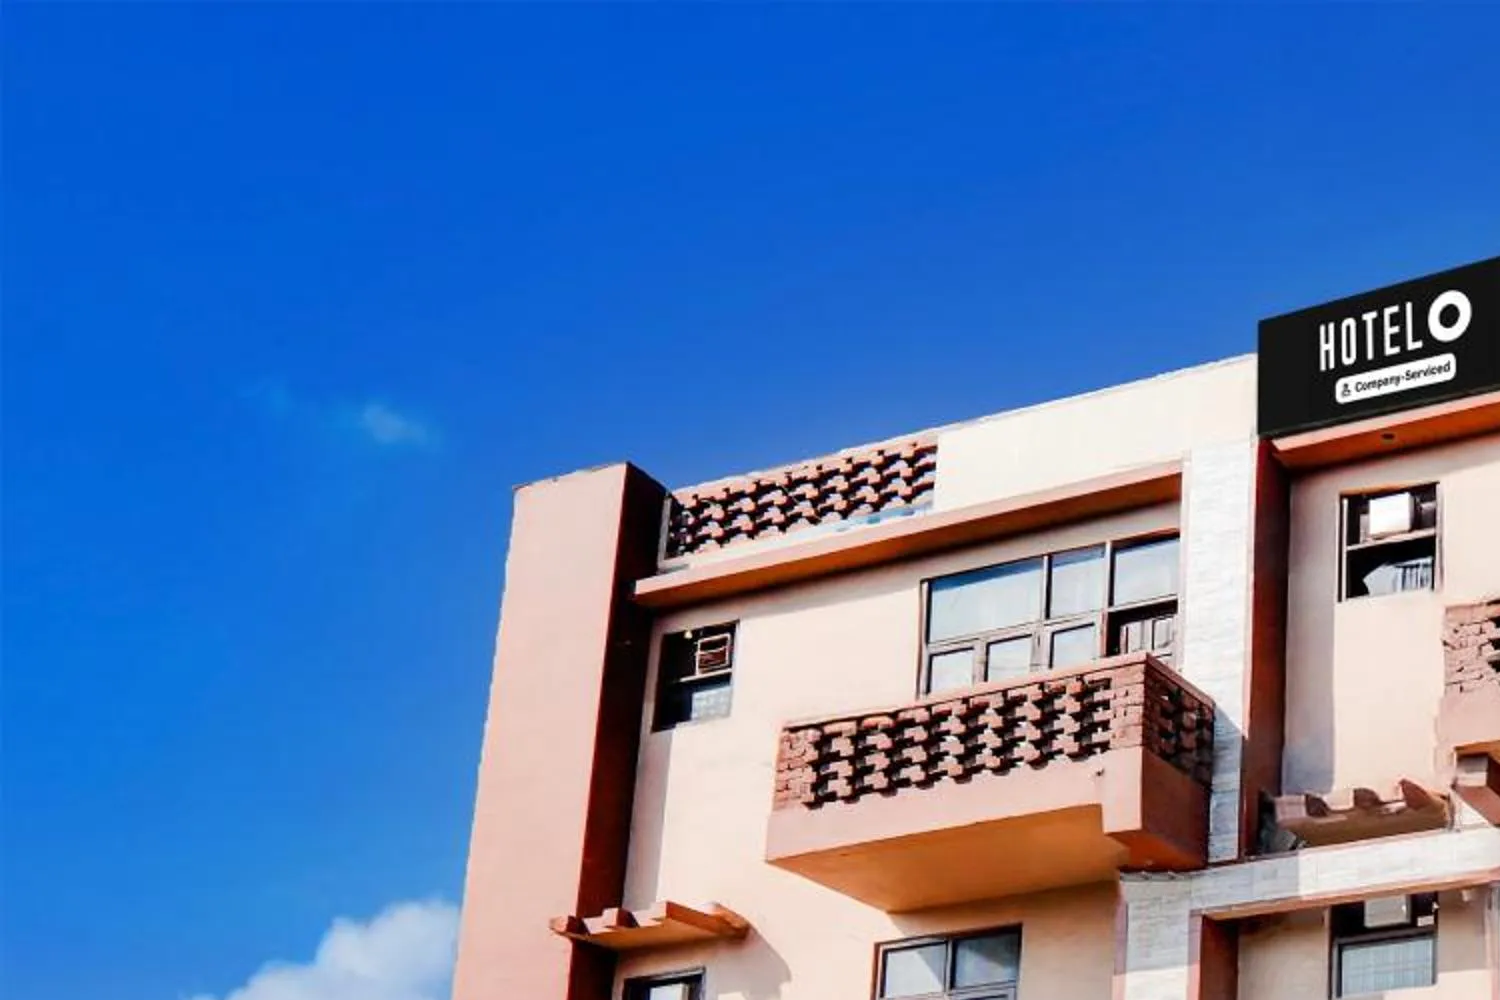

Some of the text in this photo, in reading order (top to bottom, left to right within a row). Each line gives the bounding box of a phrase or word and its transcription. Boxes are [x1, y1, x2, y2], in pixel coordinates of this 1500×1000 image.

[1319, 290, 1472, 371] HOTEL O
[1354, 360, 1451, 393] Company-Serviced
